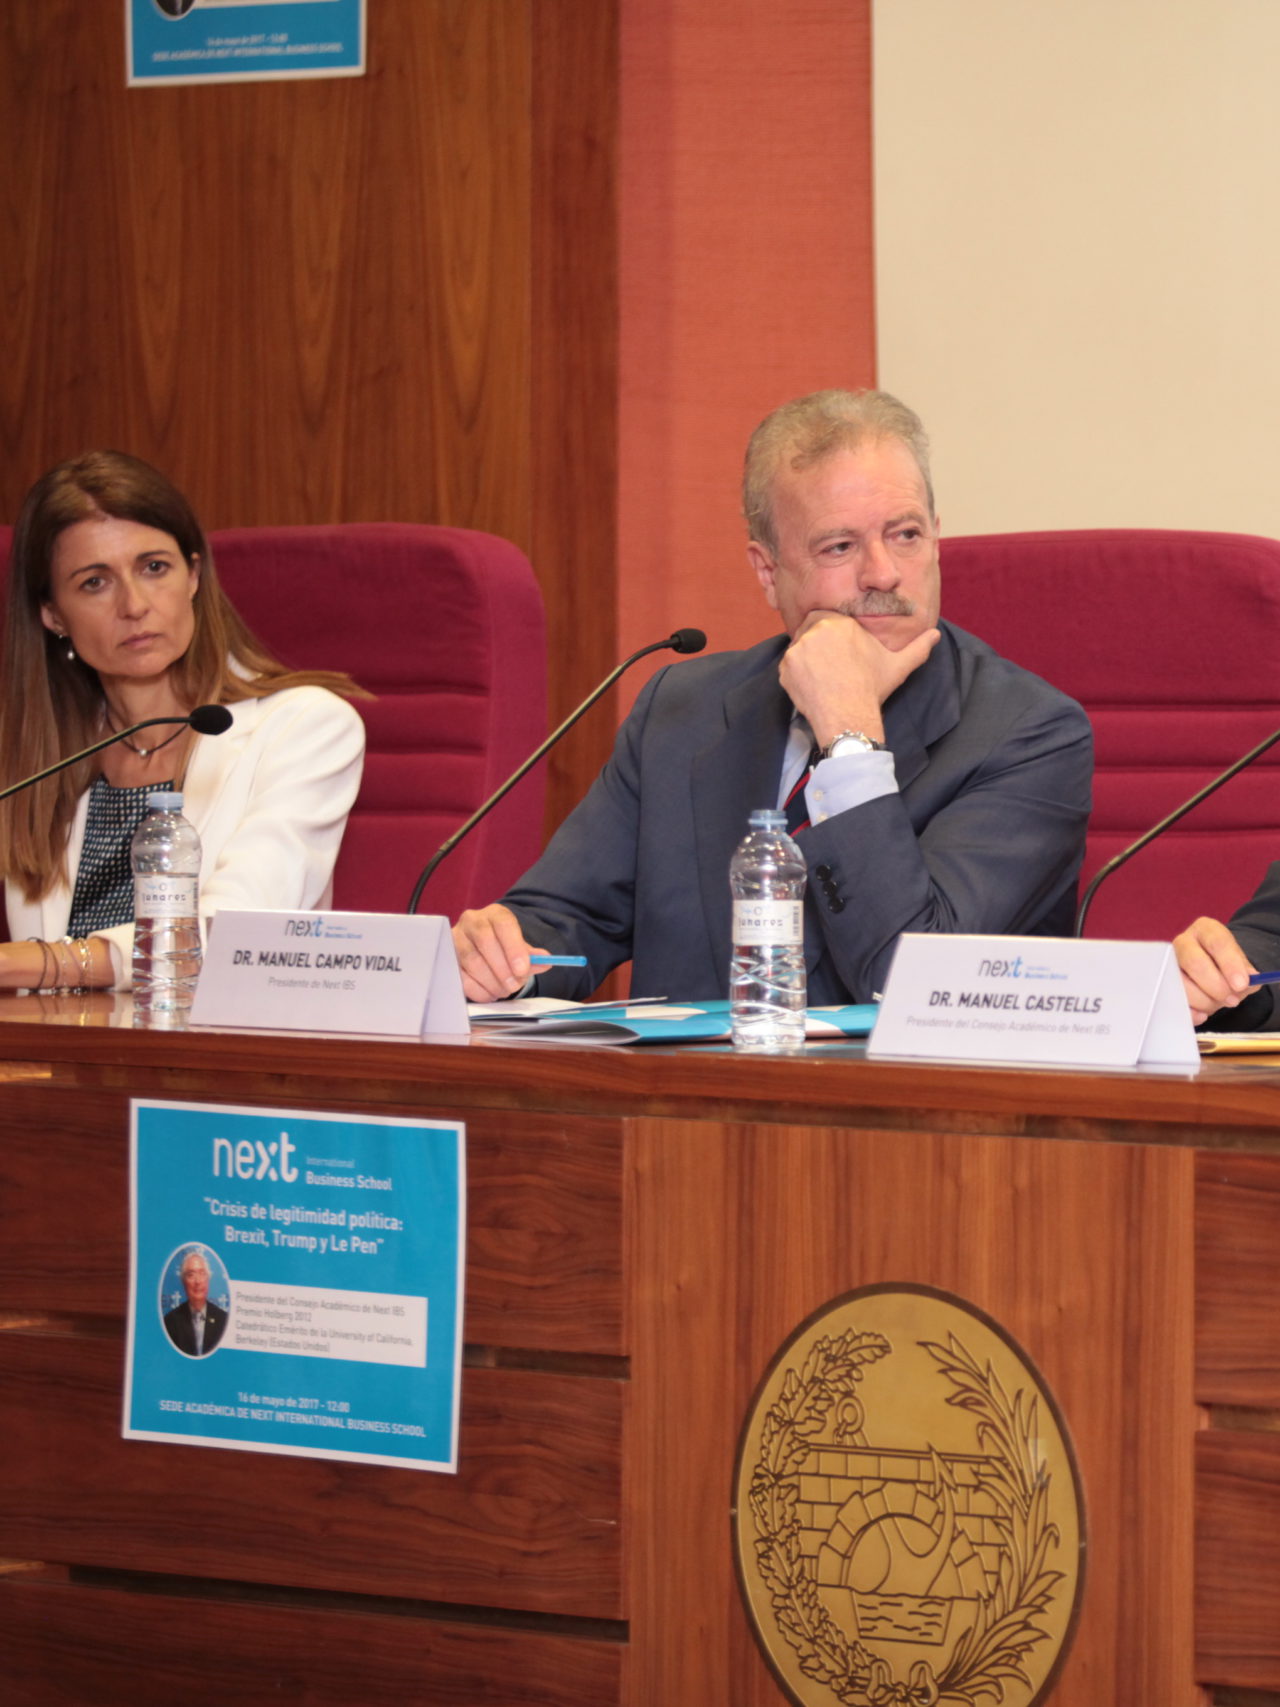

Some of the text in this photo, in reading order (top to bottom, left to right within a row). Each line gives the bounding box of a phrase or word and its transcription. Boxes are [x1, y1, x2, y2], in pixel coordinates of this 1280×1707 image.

[284, 917, 323, 937] next
[233, 950, 402, 972] DR. MANUEL CAMPO VIDAL
[978, 956, 1023, 978] next
[929, 990, 1102, 1013] DR. MANUEL CASTELLS
[213, 1131, 299, 1183] next
[305, 1171, 392, 1191] Business School
[251, 1203, 267, 1220] de
[270, 1204, 346, 1226] legitimidad
[224, 1225, 270, 1247] Brexit,
[272, 1230, 317, 1253] Trump
[319, 1238, 329, 1254] y
[331, 1234, 348, 1252] Le
